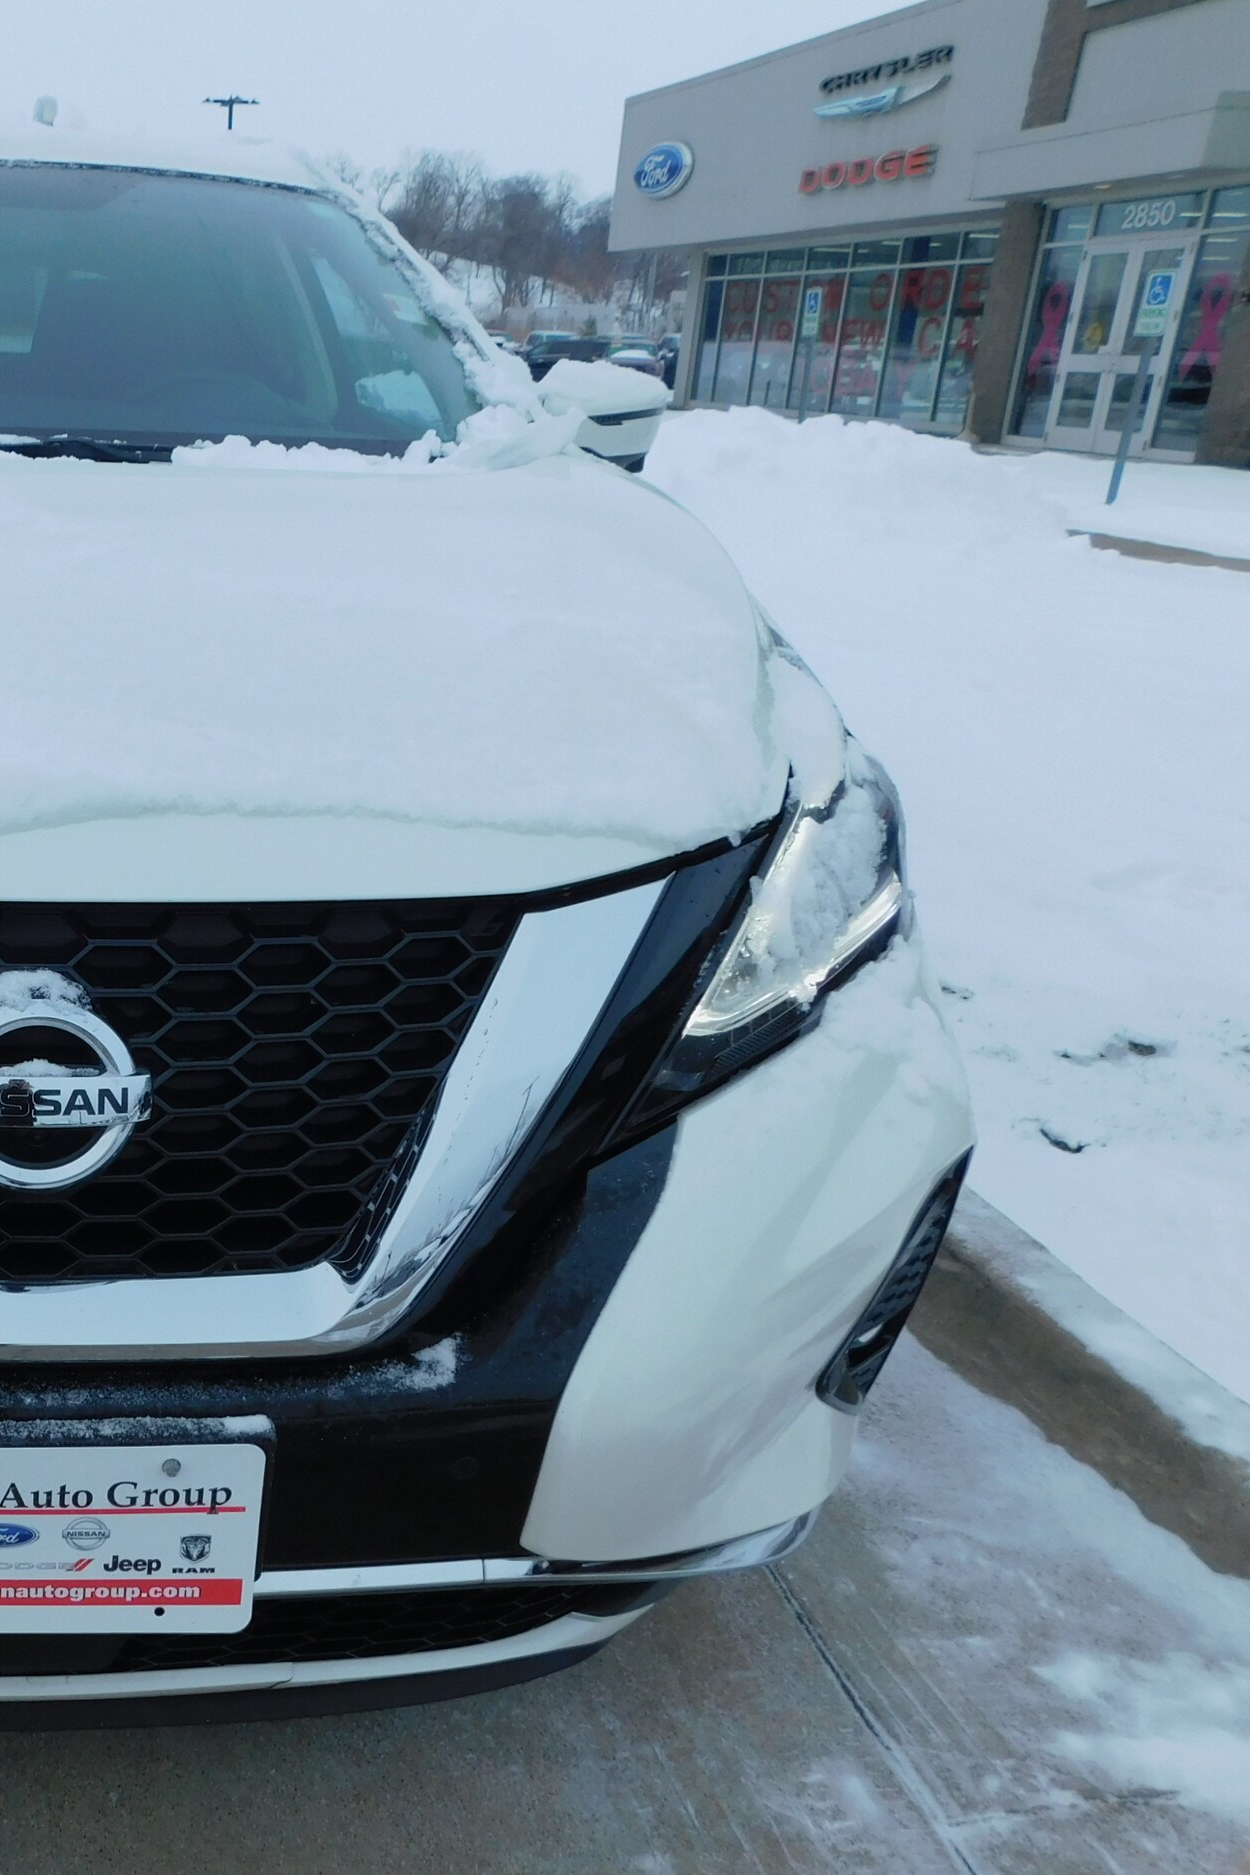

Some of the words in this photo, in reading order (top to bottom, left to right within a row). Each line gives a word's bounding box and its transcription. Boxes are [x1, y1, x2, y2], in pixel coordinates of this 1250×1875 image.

[819, 45, 955, 94] CHRYSLER
[639, 154, 672, 188] Ford
[799, 145, 936, 193] DODGE
[1121, 201, 1176, 230] 2850
[106, 1481, 232, 1515] Group
[66, 1530, 106, 1538] NISSAN
[103, 1555, 161, 1575] Jeep
